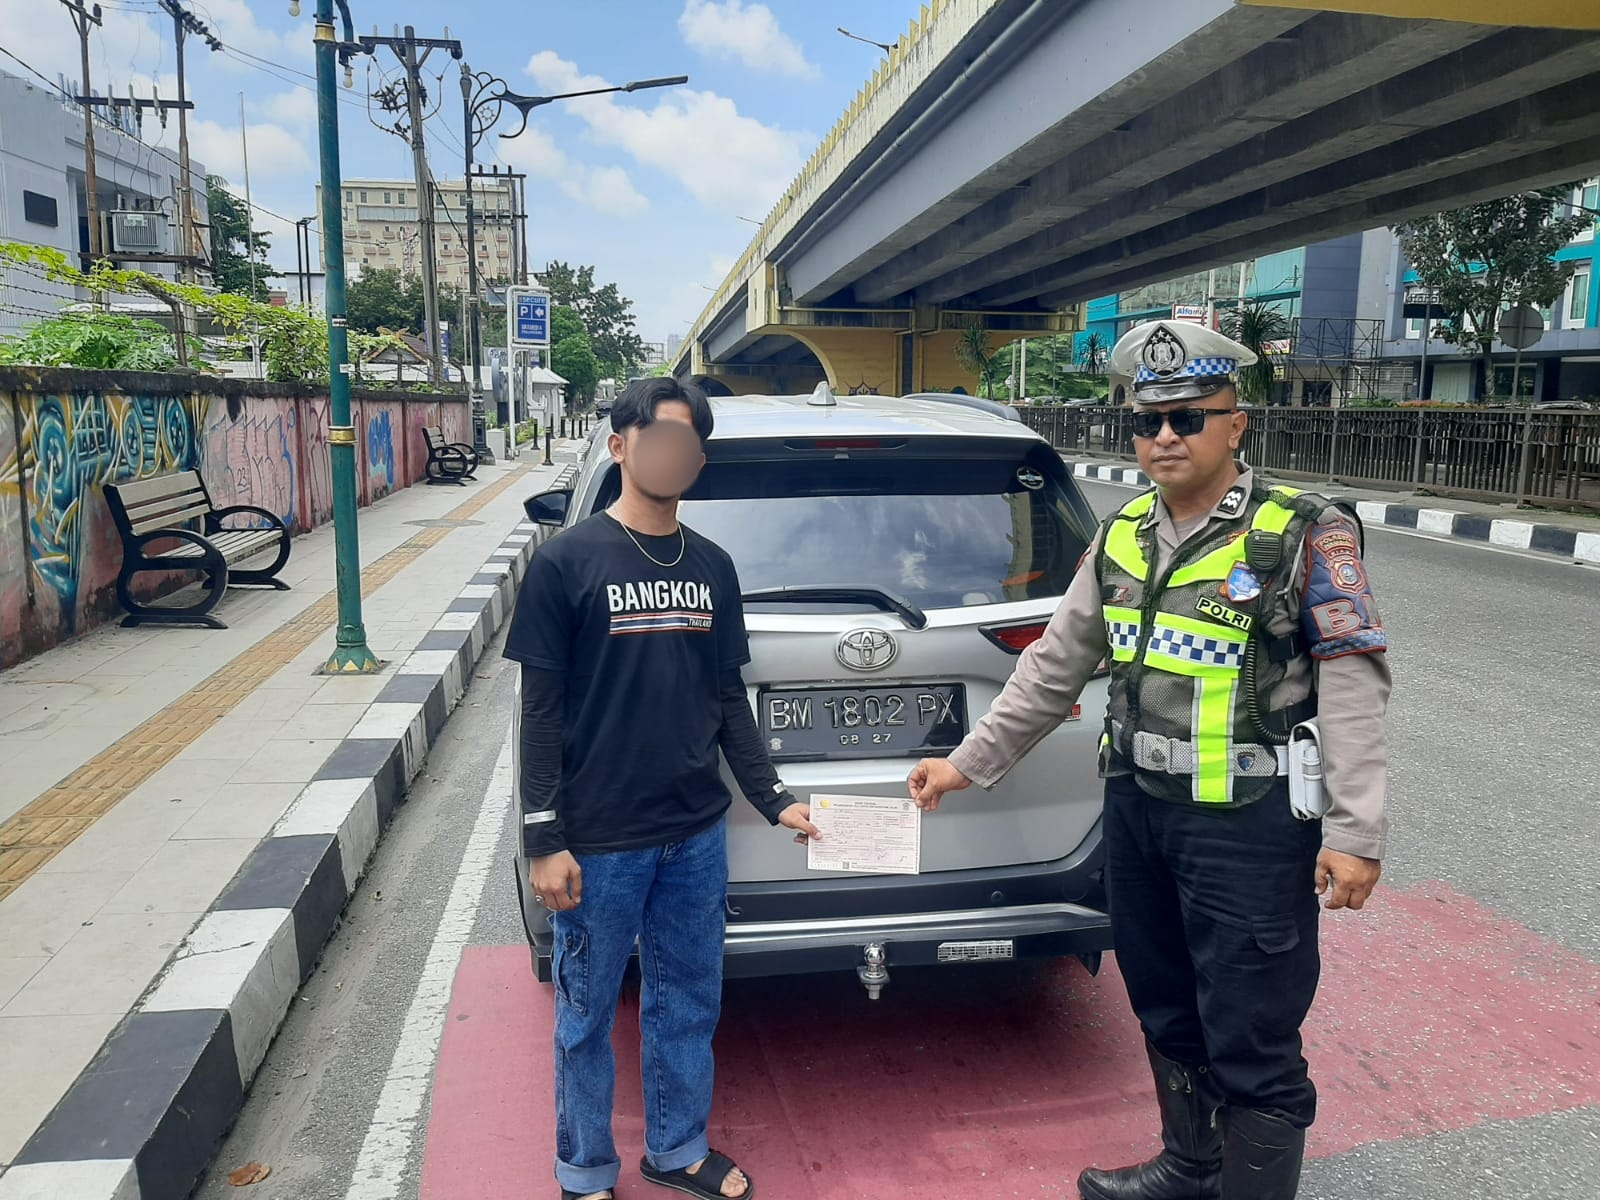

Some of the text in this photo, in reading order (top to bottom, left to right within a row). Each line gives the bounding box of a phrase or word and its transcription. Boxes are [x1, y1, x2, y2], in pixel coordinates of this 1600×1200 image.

[520, 306, 529, 317] P
[606, 580, 713, 612] BANGKOK
[688, 618, 713, 628] THAILAND
[1198, 599, 1250, 629] POLRI
[769, 693, 958, 731] BM 1802 PX
[872, 732, 892, 744] 27
